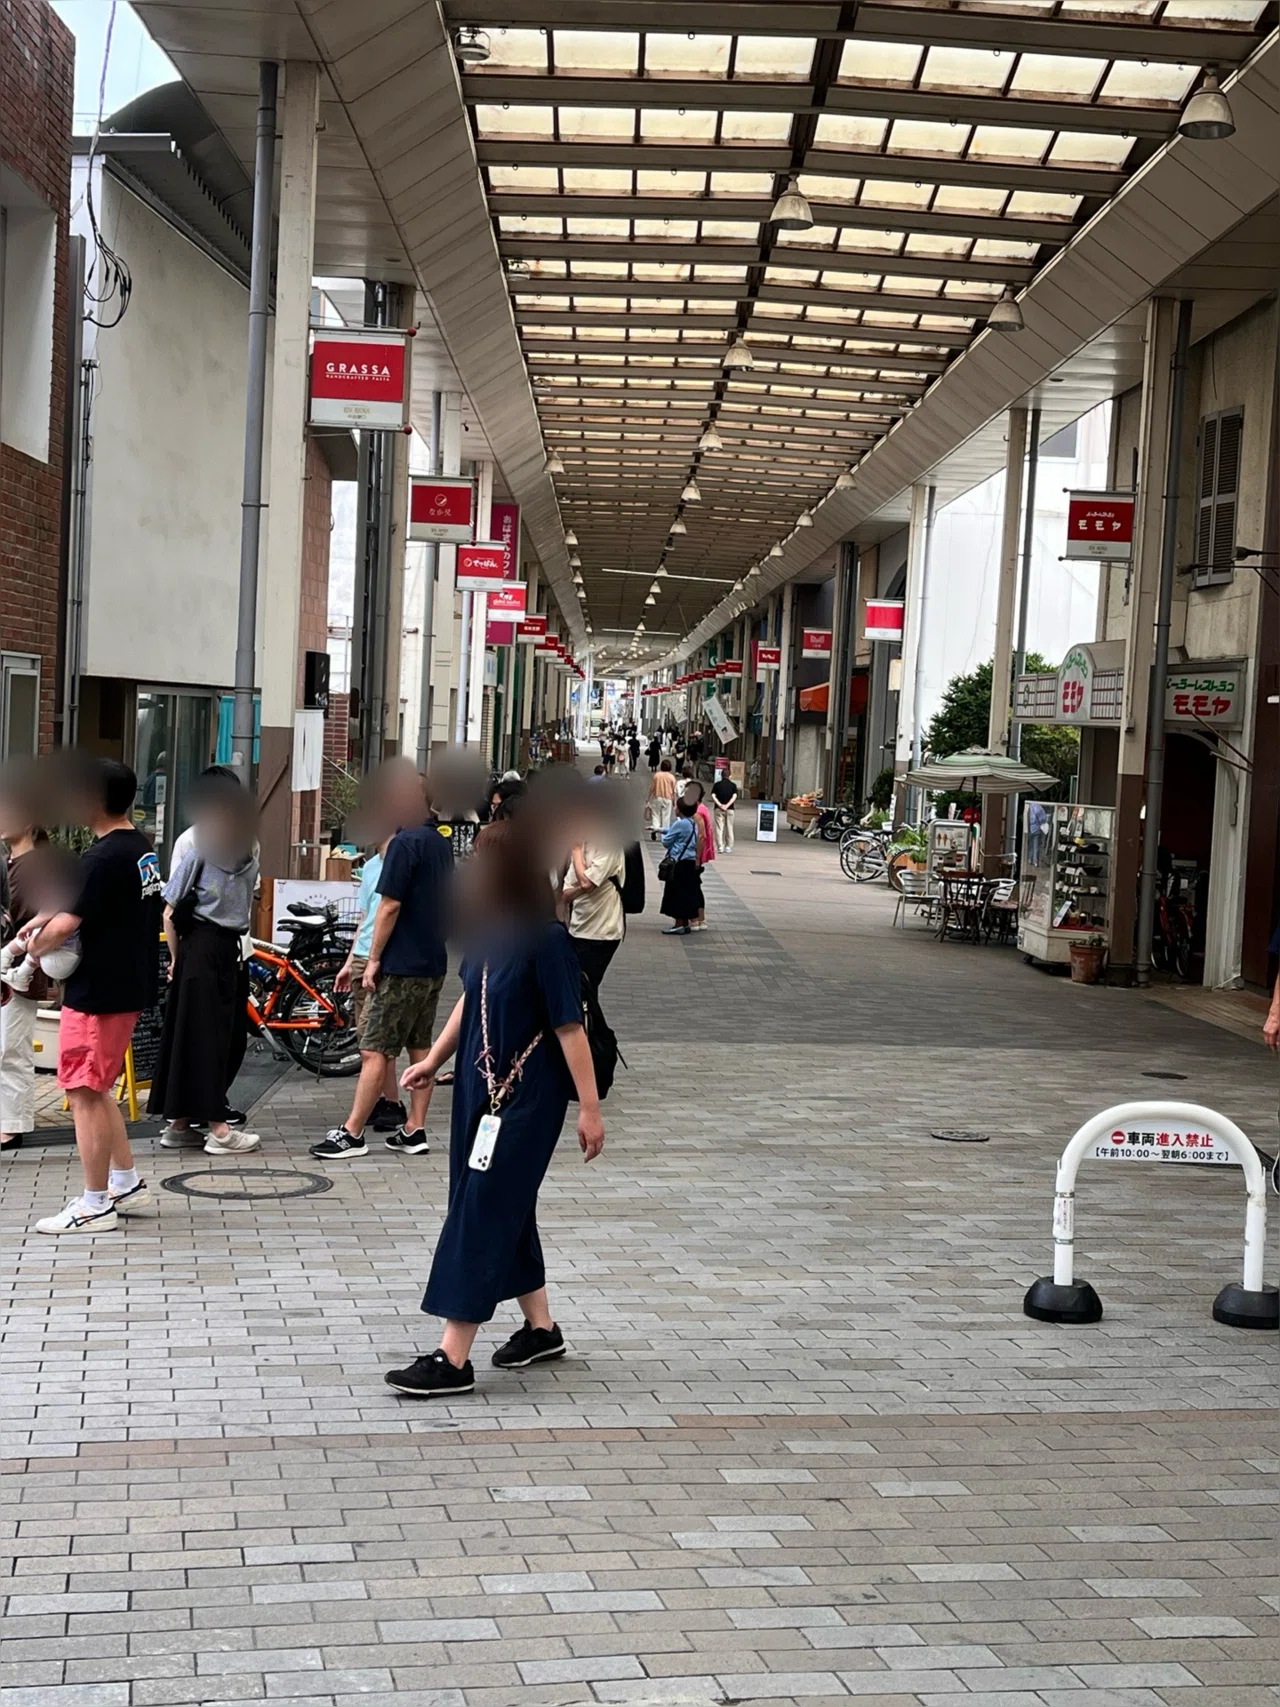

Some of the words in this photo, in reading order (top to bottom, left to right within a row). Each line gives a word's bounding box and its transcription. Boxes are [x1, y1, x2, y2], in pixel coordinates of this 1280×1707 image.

[326, 362, 390, 375] GRASSA
[1078, 519, 1121, 531] モモヤ
[1173, 694, 1231, 717] モモヤ
[1126, 1131, 1214, 1148] 車両進入禁止
